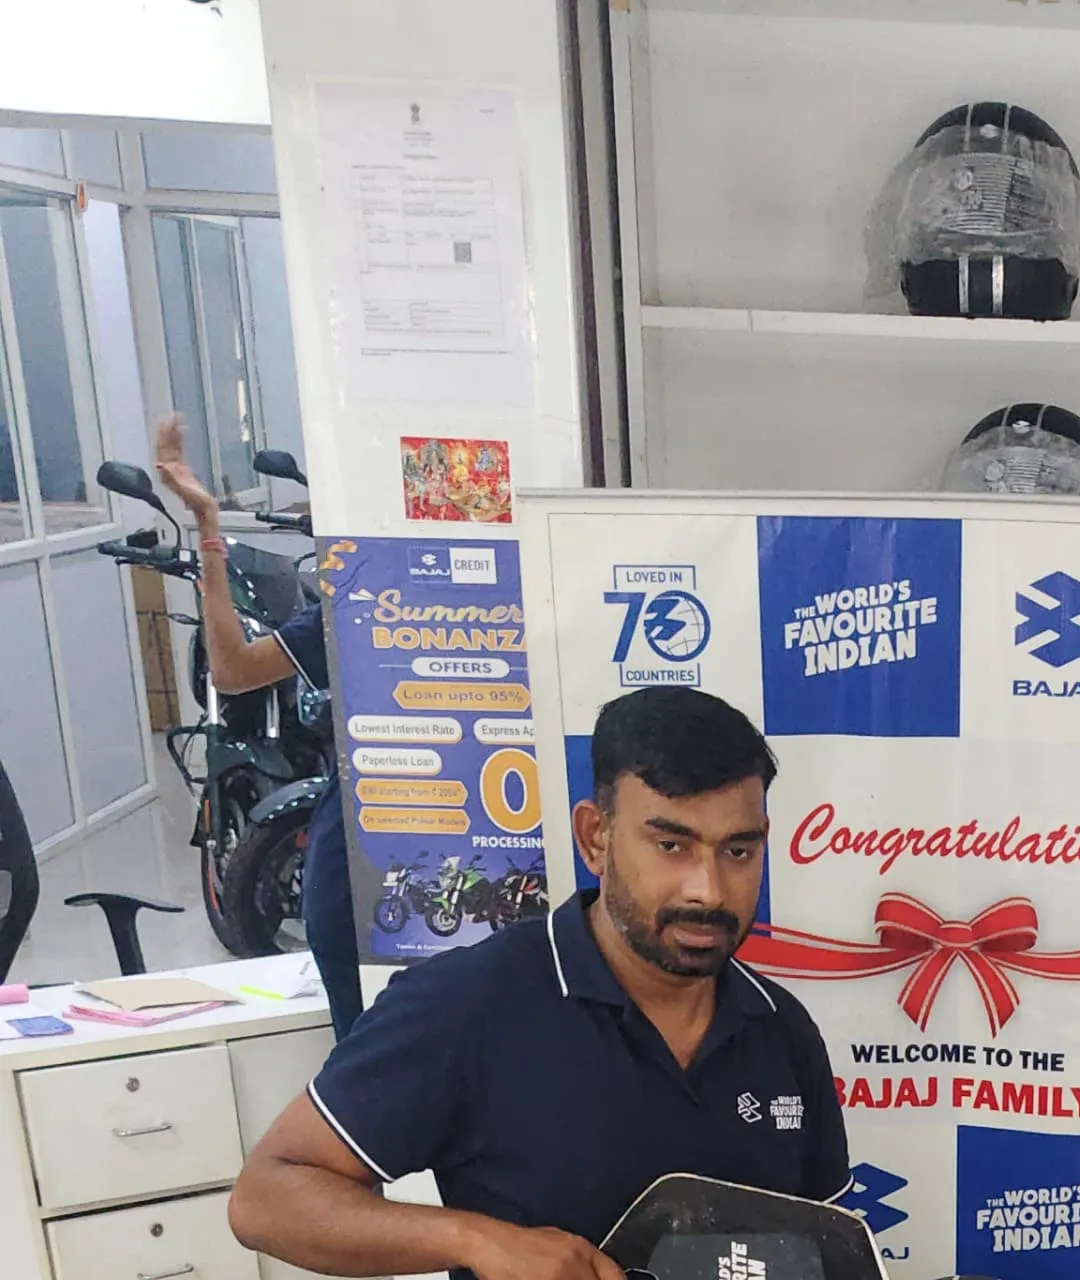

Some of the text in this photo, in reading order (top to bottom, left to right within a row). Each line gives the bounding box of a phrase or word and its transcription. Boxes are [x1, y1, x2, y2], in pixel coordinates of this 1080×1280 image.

[409, 568, 450, 576] BAJAJ
[626, 571, 683, 583] LOVED IN
[794, 579, 911, 619] THE WORLD'S
[374, 589, 525, 624] Summer
[784, 597, 937, 649] FAVOURITE
[804, 628, 917, 677] INDIAN
[429, 661, 492, 674] OFFERS
[626, 670, 695, 681] COUNTRIES
[403, 689, 523, 704] Loan upto 95%
[355, 722, 455, 736] Lowest Interest Rate
[481, 724, 520, 737] Express
[362, 755, 434, 768] Paperless Loan
[851, 1043, 1065, 1072] WELCOME TO THE
[986, 1198, 1004, 1208] THE
